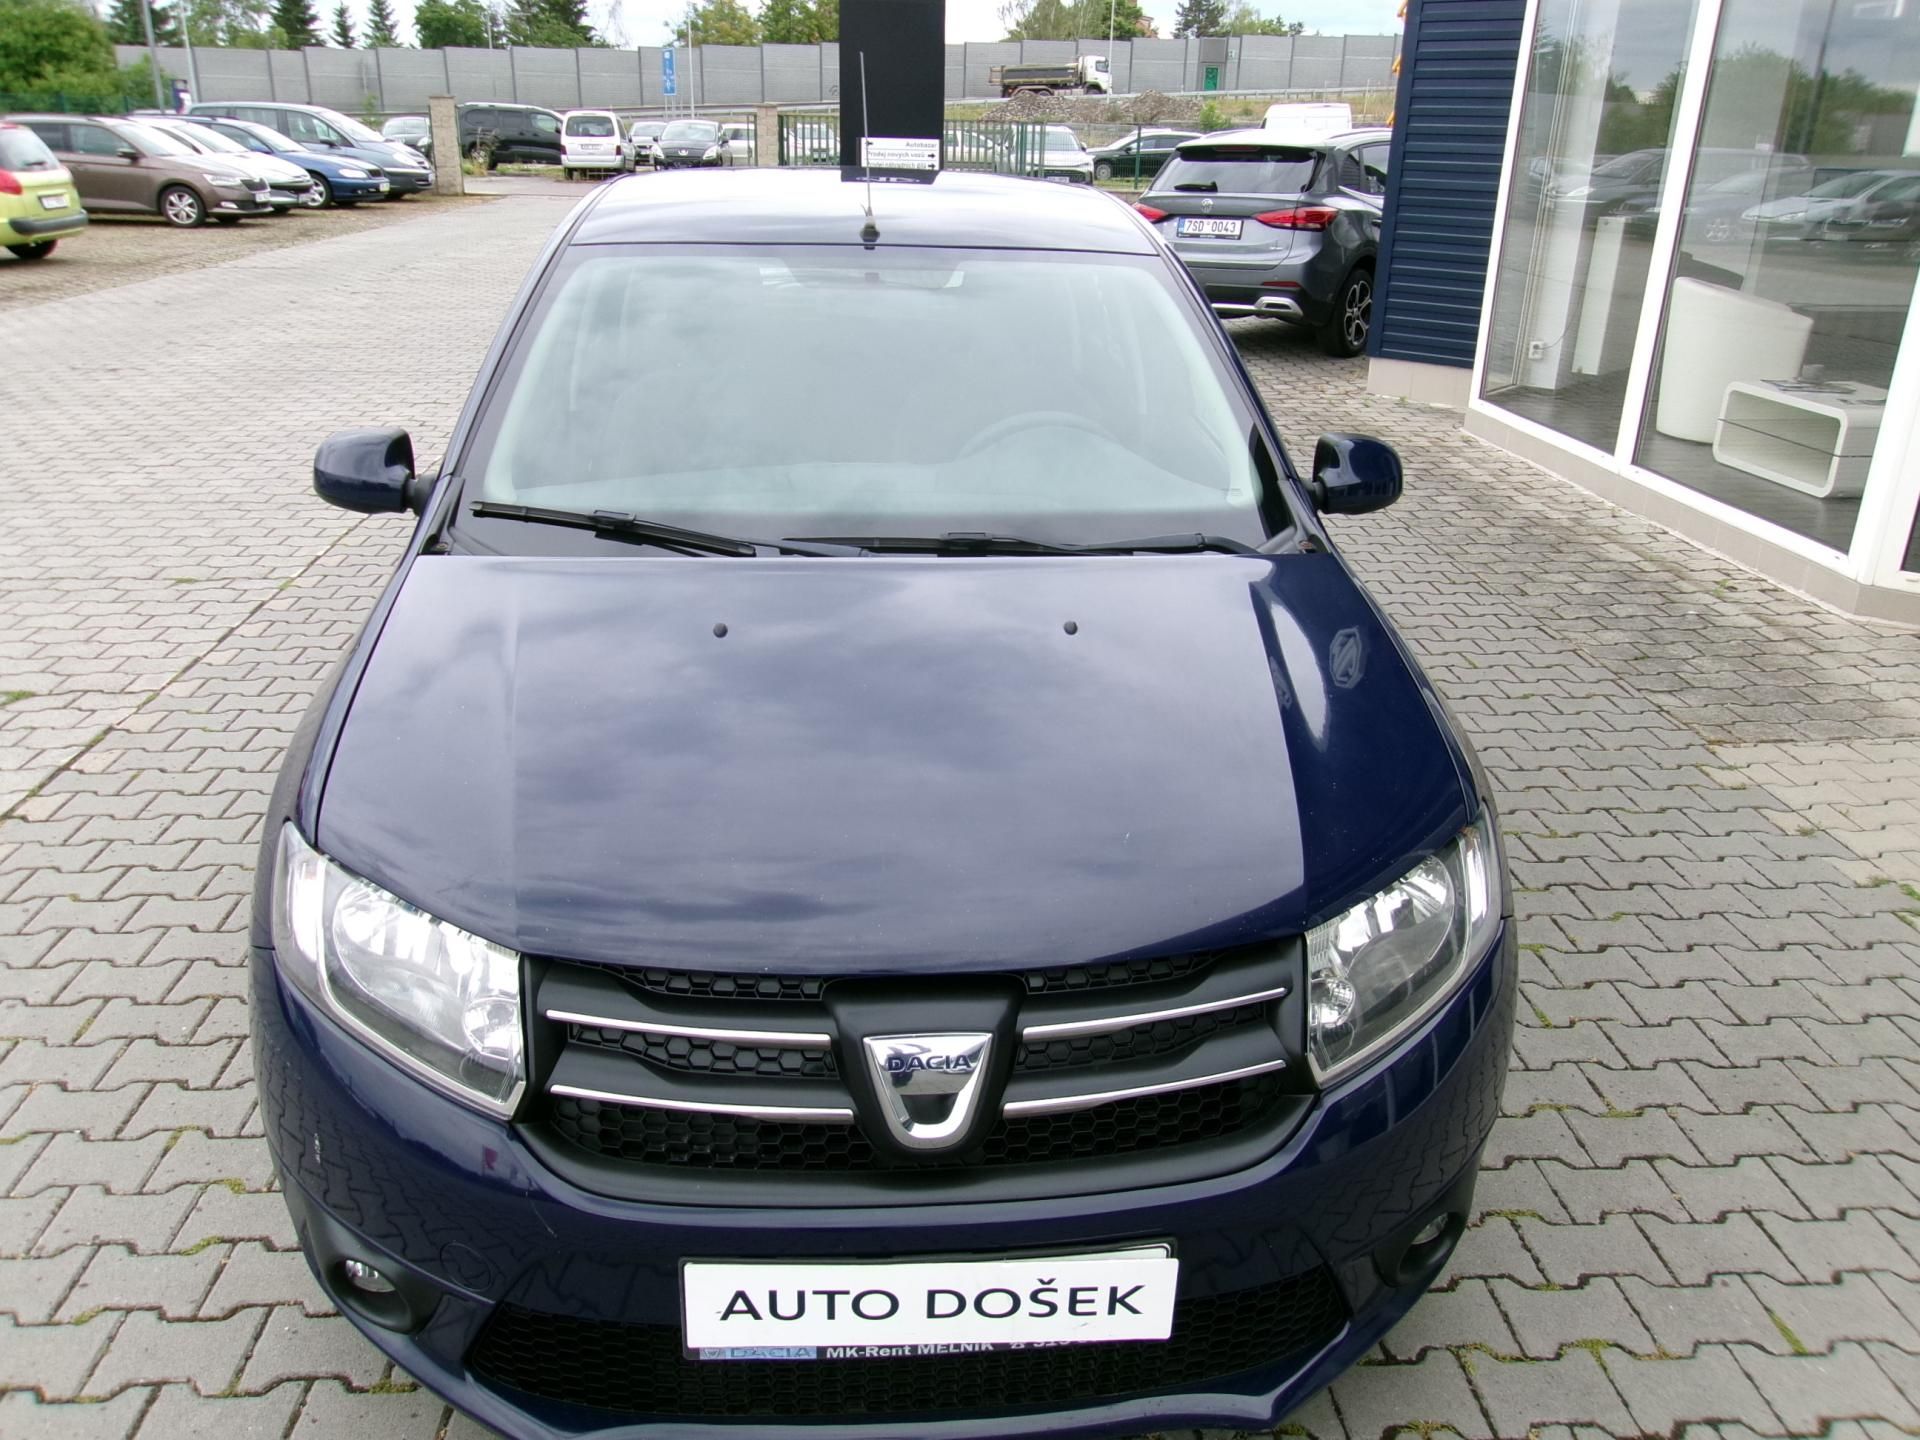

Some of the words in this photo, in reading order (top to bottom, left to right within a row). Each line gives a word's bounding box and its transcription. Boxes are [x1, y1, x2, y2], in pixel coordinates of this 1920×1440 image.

[1186, 220, 1205, 232] 7SD
[1211, 221, 1237, 233] 0043
[887, 1054, 973, 1073] DACIA
[719, 1289, 900, 1321] AUTO
[926, 1277, 1146, 1319] DOŠEK
[826, 1345, 911, 1358] MK-Rent
